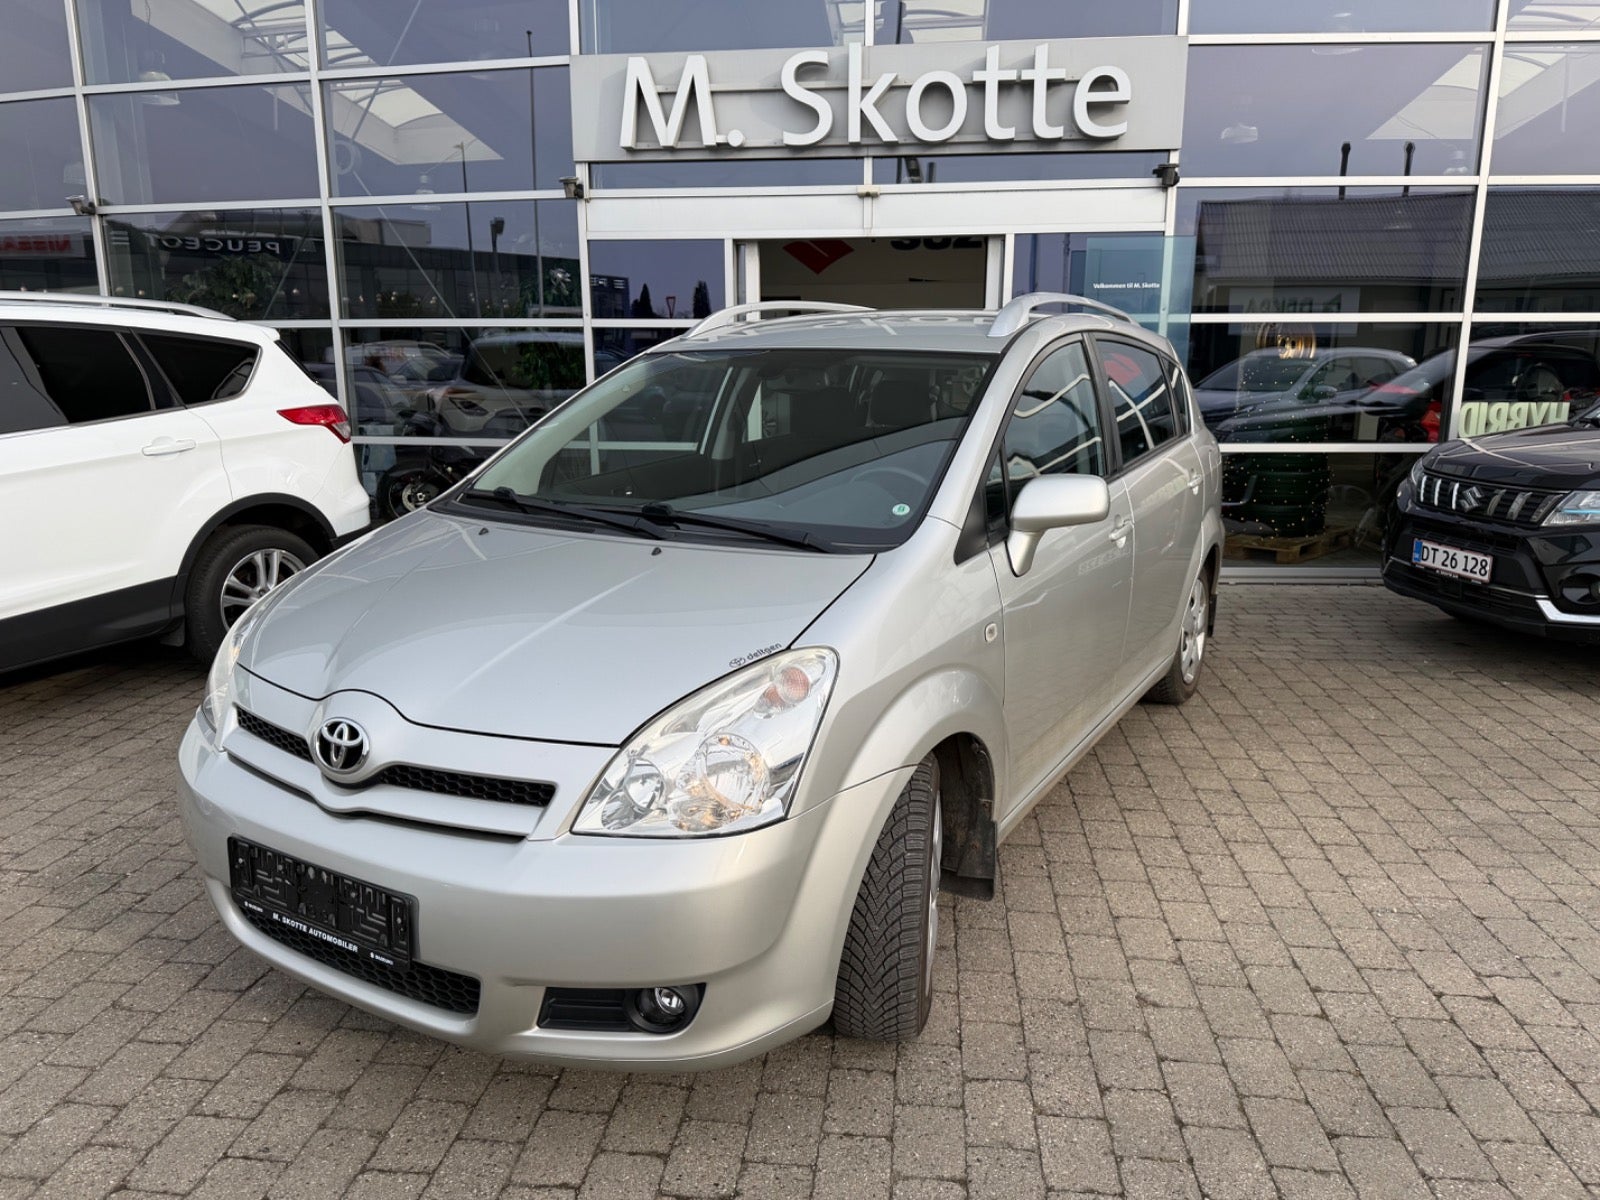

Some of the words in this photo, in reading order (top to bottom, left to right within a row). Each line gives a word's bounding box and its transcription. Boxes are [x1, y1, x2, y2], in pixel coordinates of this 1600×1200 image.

[619, 53, 746, 149] M.
[780, 42, 1132, 147] Skotte
[1421, 545, 1439, 564] DT
[1441, 550, 1458, 569] 26
[1462, 555, 1489, 577] 128
[272, 912, 281, 922] M.
[281, 916, 308, 933] SKOTTE
[308, 927, 359, 953] AUTOMOBILER
